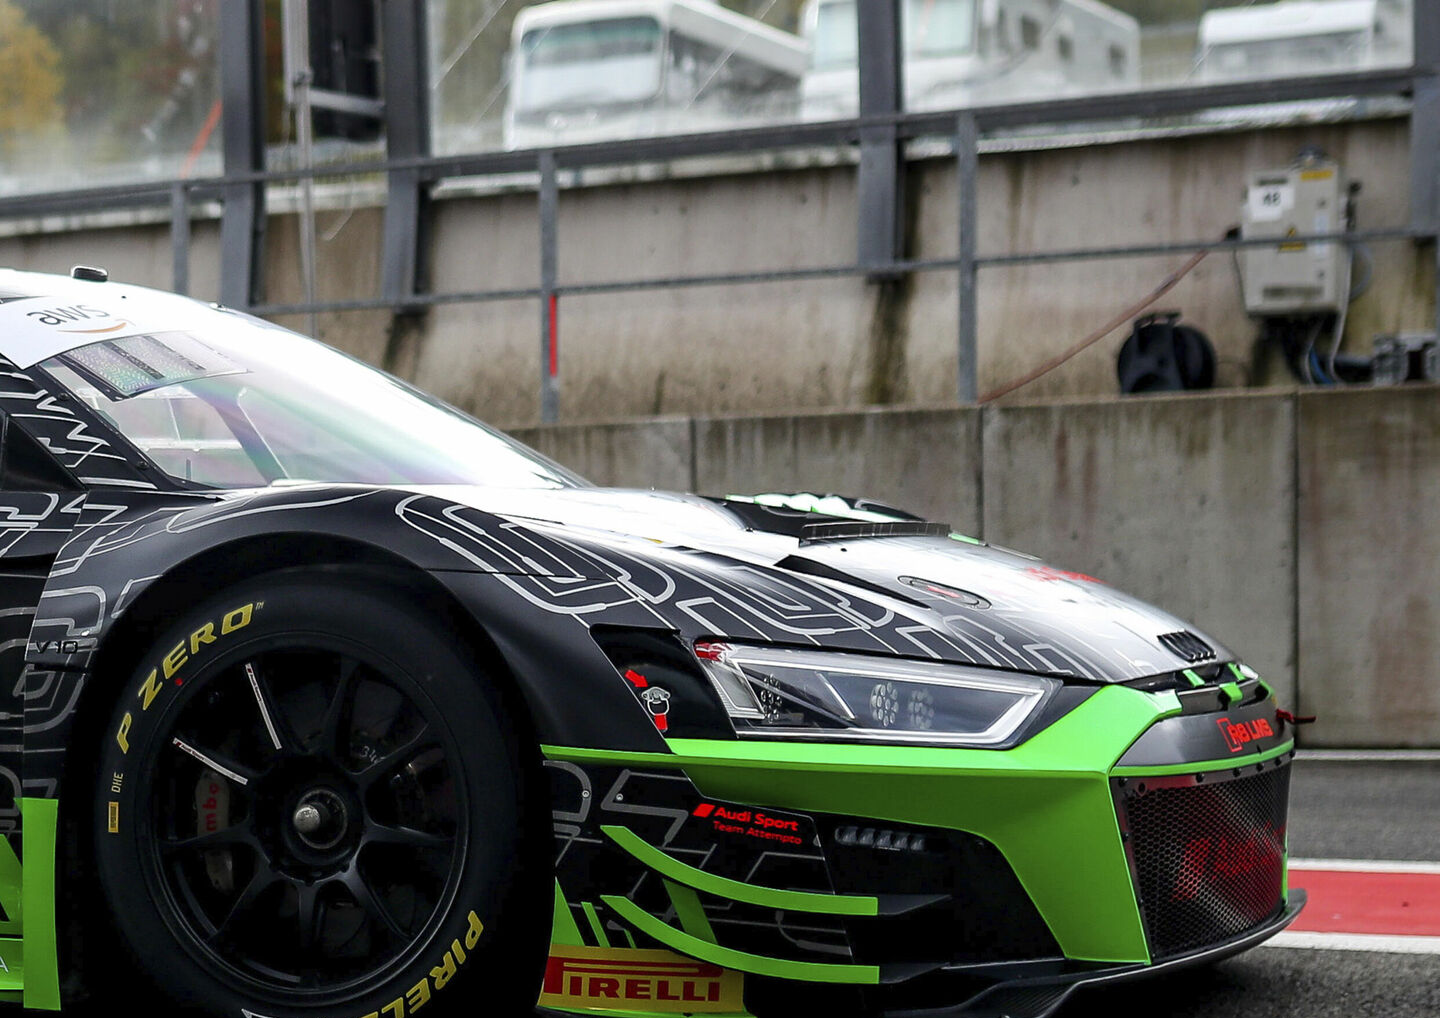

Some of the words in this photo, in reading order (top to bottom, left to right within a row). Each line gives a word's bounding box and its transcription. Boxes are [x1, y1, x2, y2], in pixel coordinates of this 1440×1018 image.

[26, 304, 111, 325] aws
[116, 712, 133, 755] P
[137, 602, 254, 711] ZERO
[713, 820, 744, 834] Team
[714, 806, 752, 823] Audi
[754, 813, 799, 832] Sport
[543, 956, 724, 1002] PIRELLI
